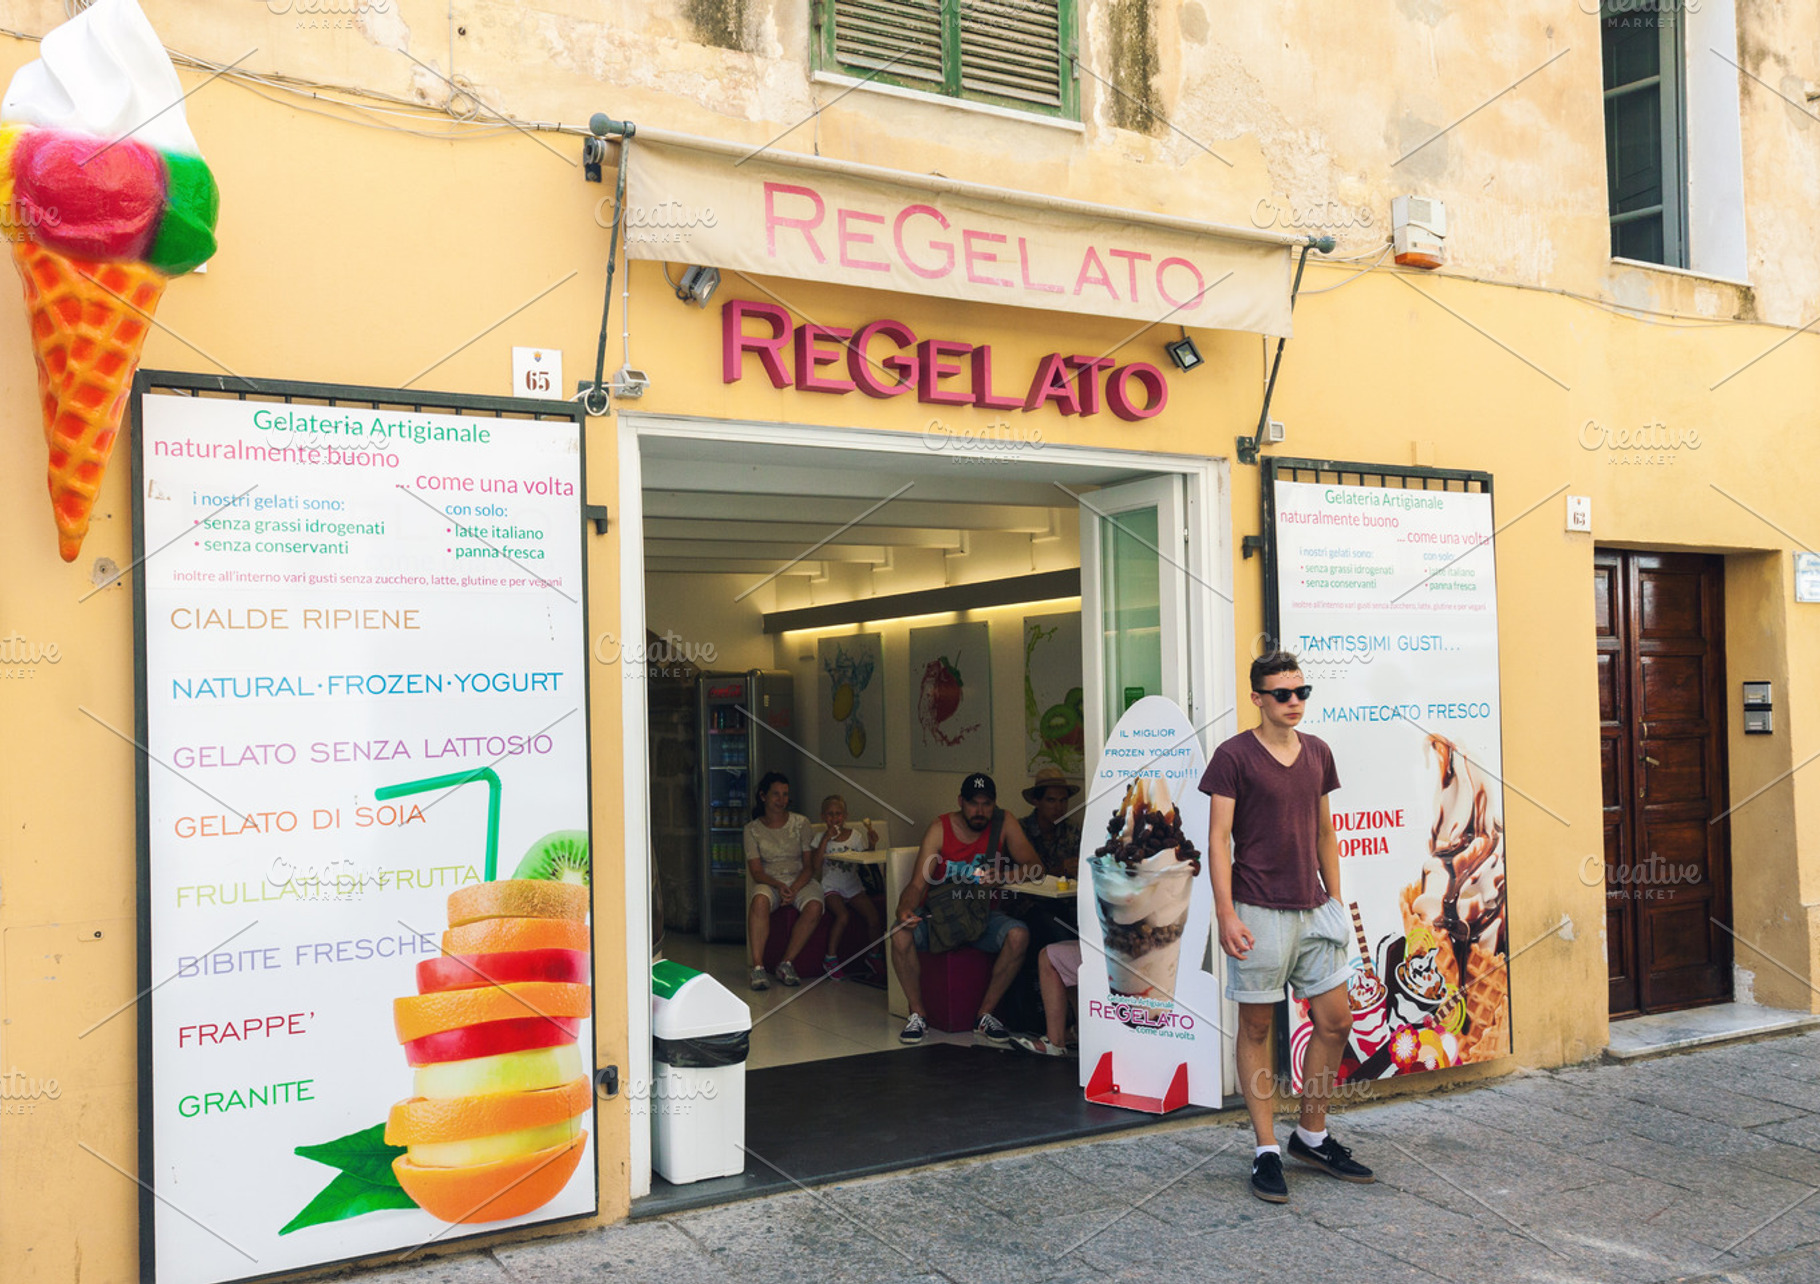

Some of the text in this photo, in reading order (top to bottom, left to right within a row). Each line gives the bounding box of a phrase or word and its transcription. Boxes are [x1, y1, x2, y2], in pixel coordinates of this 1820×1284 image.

[763, 181, 1205, 310] REGELATO
[722, 299, 1168, 421] REGELATO
[525, 369, 550, 392] 65
[253, 409, 491, 444] Gelateria Artigianale
[154, 438, 399, 468] naturalmente buono
[416, 475, 474, 491] come
[480, 478, 518, 493] una
[523, 476, 574, 496] volta
[193, 491, 345, 511] i nostri gelati sono:
[1325, 489, 1443, 511] Gelateria Artigianale
[446, 504, 508, 517] con solo:
[1280, 509, 1399, 528] naturalmente buono
[1573, 511, 1585, 526] 63
[203, 518, 385, 537] senza grassi idrogenati
[455, 523, 543, 539] latte italiano
[204, 539, 349, 554] senza conservanti
[1407, 532, 1437, 544] come
[1440, 532, 1460, 544] una
[1462, 532, 1489, 546] volta
[455, 545, 545, 560] panna fresca
[1303, 547, 1327, 557] nostri
[1329, 547, 1351, 559] gelati
[1423, 552, 1437, 561] con
[1305, 563, 1394, 576] senza grassi idrogenati
[173, 570, 215, 582] inoltre
[218, 570, 281, 583] all'interno
[283, 571, 306, 583] vari
[308, 572, 337, 585] gusti
[340, 575, 373, 584] senza
[375, 574, 429, 586] zucchero,
[431, 575, 459, 586] latte,
[461, 575, 498, 587] glutine
[509, 578, 526, 588] per
[528, 577, 562, 589] vegani
[1306, 579, 1376, 589] senza conservanti
[1429, 581, 1477, 592] panna fresca
[170, 608, 421, 630] CIALDE RIPIENE
[1299, 635, 1460, 651] TANTISSIMI GUSTI...
[1427, 702, 1490, 719] FRESCO
[1120, 729, 1176, 738] IL MIGLIOR
[173, 734, 553, 769] GELATO SENZA LATTOSIO
[1105, 748, 1191, 757] FROZEN YOGURT
[1100, 768, 1198, 779] LO TROVATE QUI!!!
[174, 804, 426, 839] GELATO DI SOIA
[1332, 809, 1405, 831] DUZIONE
[1338, 836, 1389, 858] OPRIA
[176, 865, 479, 908] FRULLATI DI FRUTTA
[177, 933, 436, 978] BIBITE FRESCHE
[1138, 998, 1175, 1009] Artigianale
[1089, 1000, 1194, 1030] REGELATO
[178, 1011, 315, 1048] FRAPPE'
[1136, 1026, 1157, 1036] come
[1175, 1032, 1195, 1040] volta
[178, 1079, 315, 1117] GRANITE
